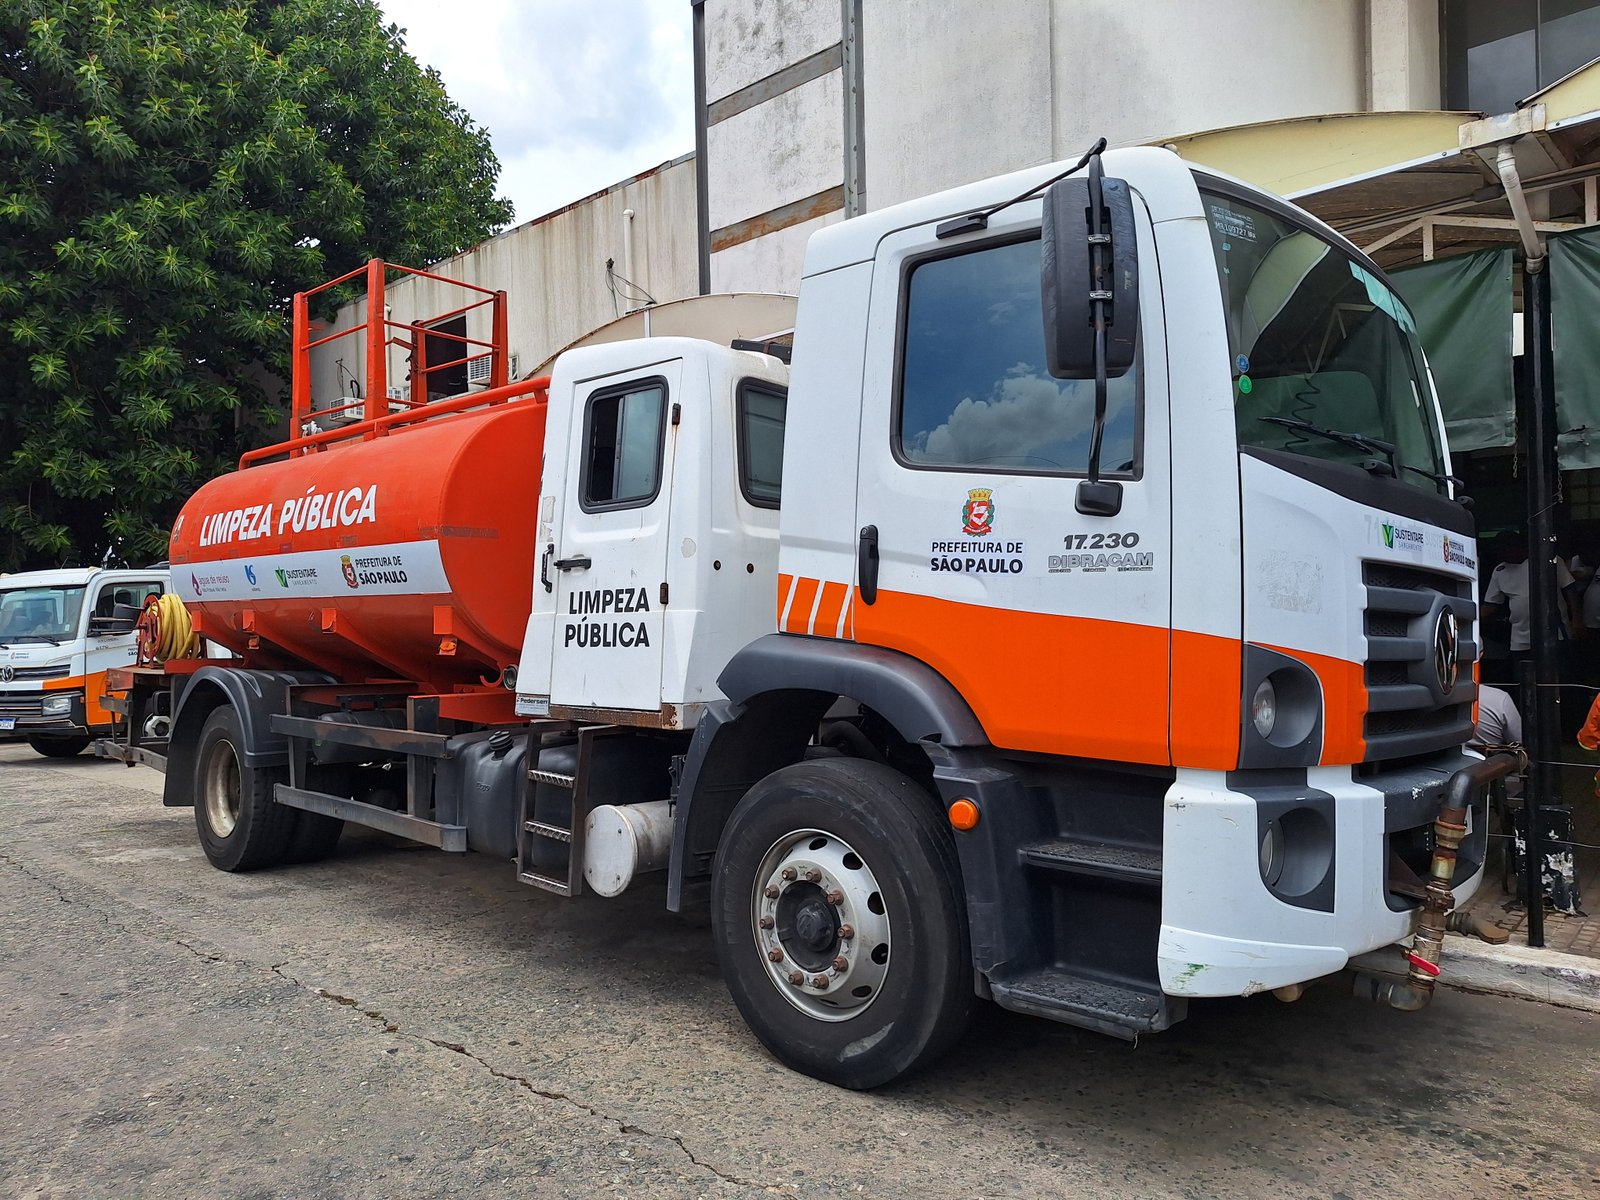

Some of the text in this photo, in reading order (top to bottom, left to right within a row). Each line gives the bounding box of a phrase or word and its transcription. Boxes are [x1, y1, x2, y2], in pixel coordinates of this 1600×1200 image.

[199, 485, 378, 547] LIMPEZA PÚBLICA
[1064, 532, 1140, 550] 17.230
[1395, 528, 1424, 544] SUSTENTARE
[931, 542, 1023, 553] PREFEITURA DE
[354, 556, 402, 568] PREFEITURA DE
[930, 555, 1024, 574] SÃO PAULO
[1048, 552, 1154, 568] DIBRACAM
[286, 568, 318, 579] SUSTENTARE
[358, 570, 408, 585] SÃO PAULO
[569, 587, 650, 615] LIMPEZA
[564, 616, 650, 648] PÚBLICA
[520, 697, 548, 705] Pedersen
